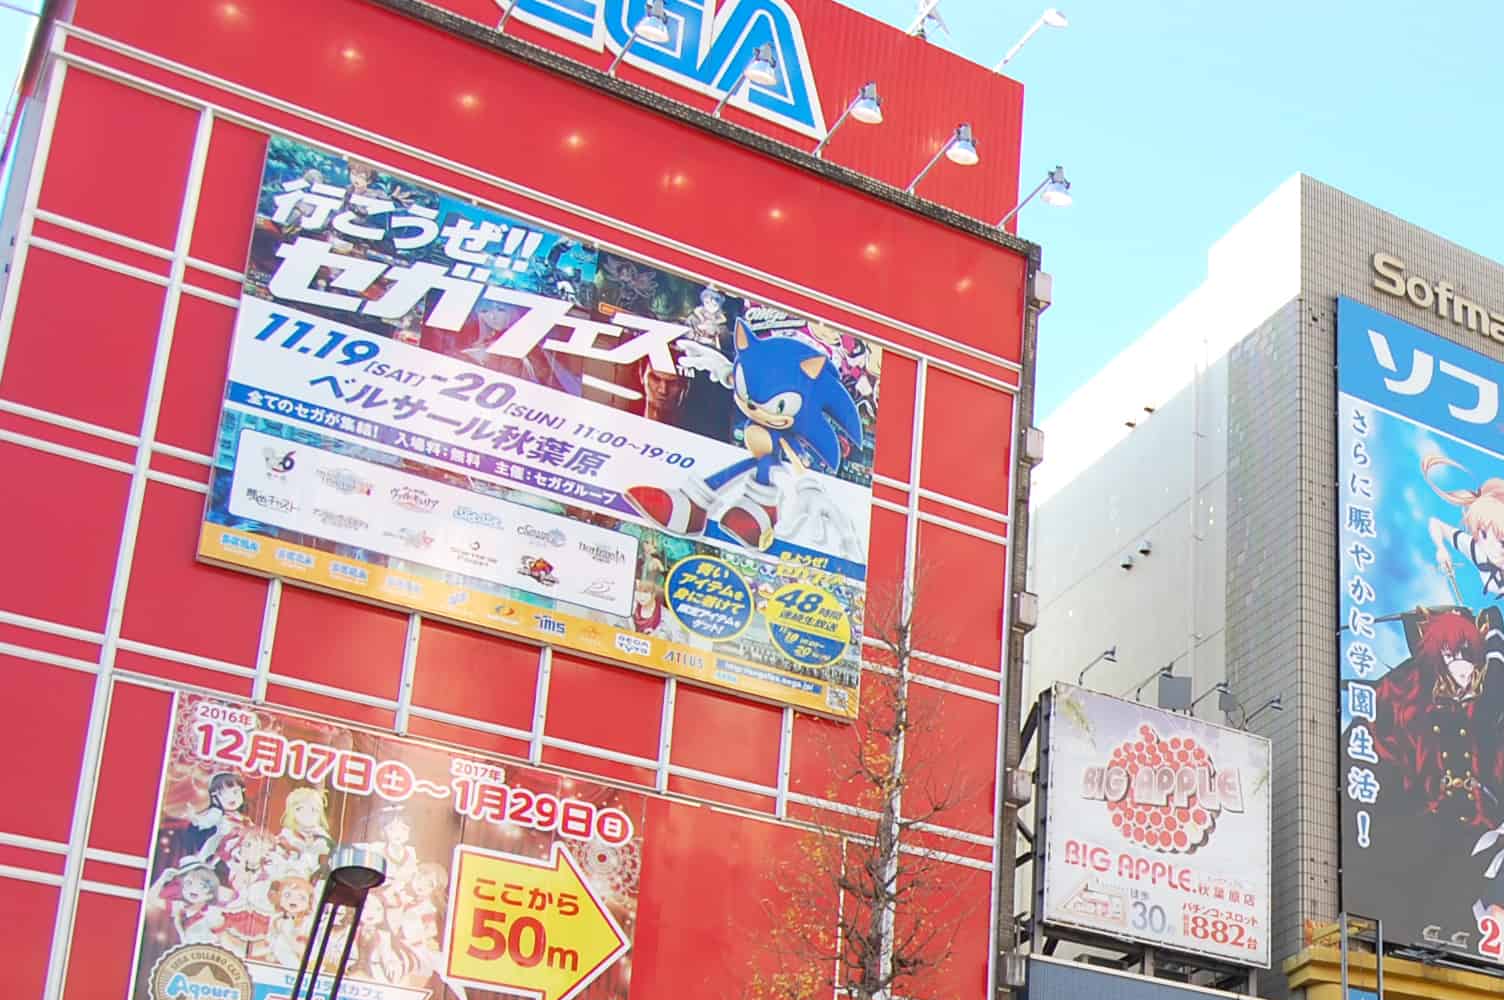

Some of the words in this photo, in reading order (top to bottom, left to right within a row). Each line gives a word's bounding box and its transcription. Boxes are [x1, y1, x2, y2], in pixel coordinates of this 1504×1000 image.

[267, 237, 690, 376] セガフェス
[255, 312, 381, 366] 11.19
[309, 375, 612, 477] ベルサール秋葉原
[776, 588, 824, 614] 48
[198, 705, 253, 729] 2016年
[452, 760, 504, 785] 2017年
[1082, 767, 1131, 803] BIG
[1132, 766, 1245, 813] APPLE
[1065, 839, 1112, 872] BIG
[473, 875, 581, 918] ここから
[465, 913, 579, 974] 50m
